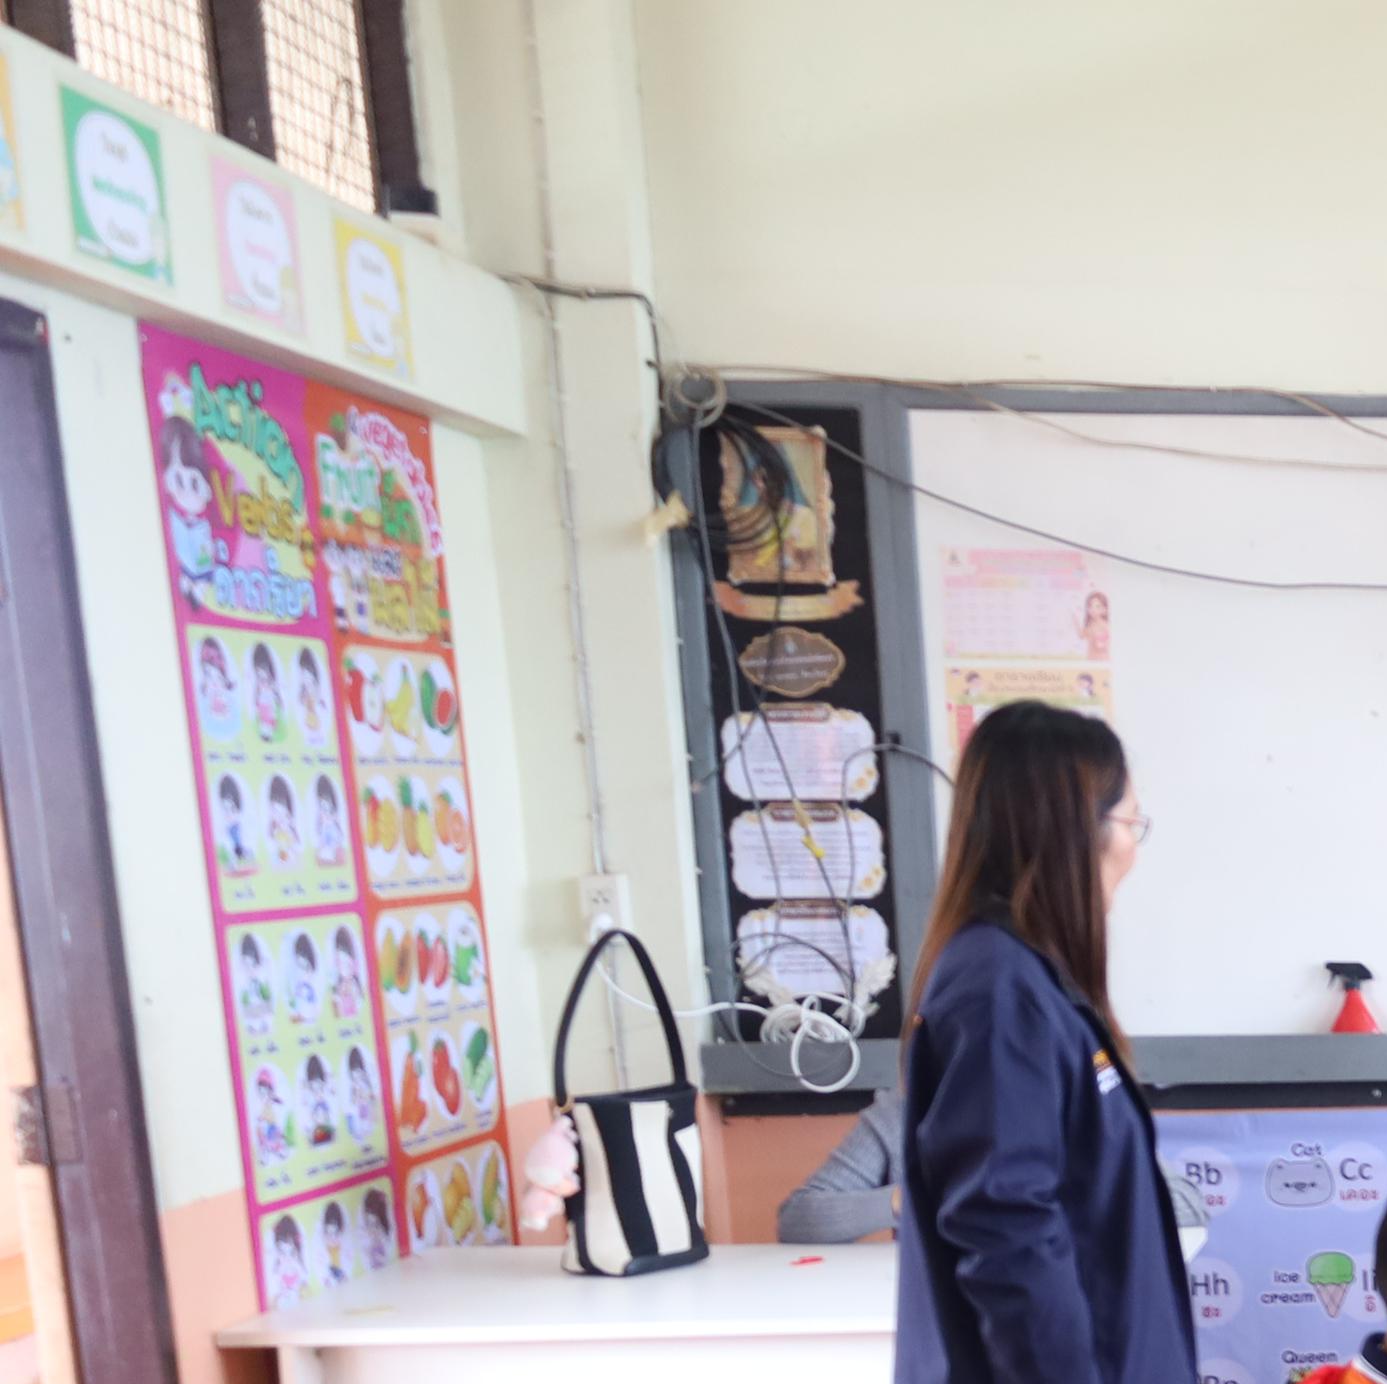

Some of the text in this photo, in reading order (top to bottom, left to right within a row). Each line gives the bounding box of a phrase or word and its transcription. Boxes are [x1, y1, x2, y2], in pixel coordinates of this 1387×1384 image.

[1291, 1142, 1323, 1157] Cat
[1185, 1161, 1223, 1185] Bb
[1339, 1157, 1373, 1181] Cc
[1190, 1271, 1230, 1296] Hh
[1281, 1350, 1338, 1364] Queen
